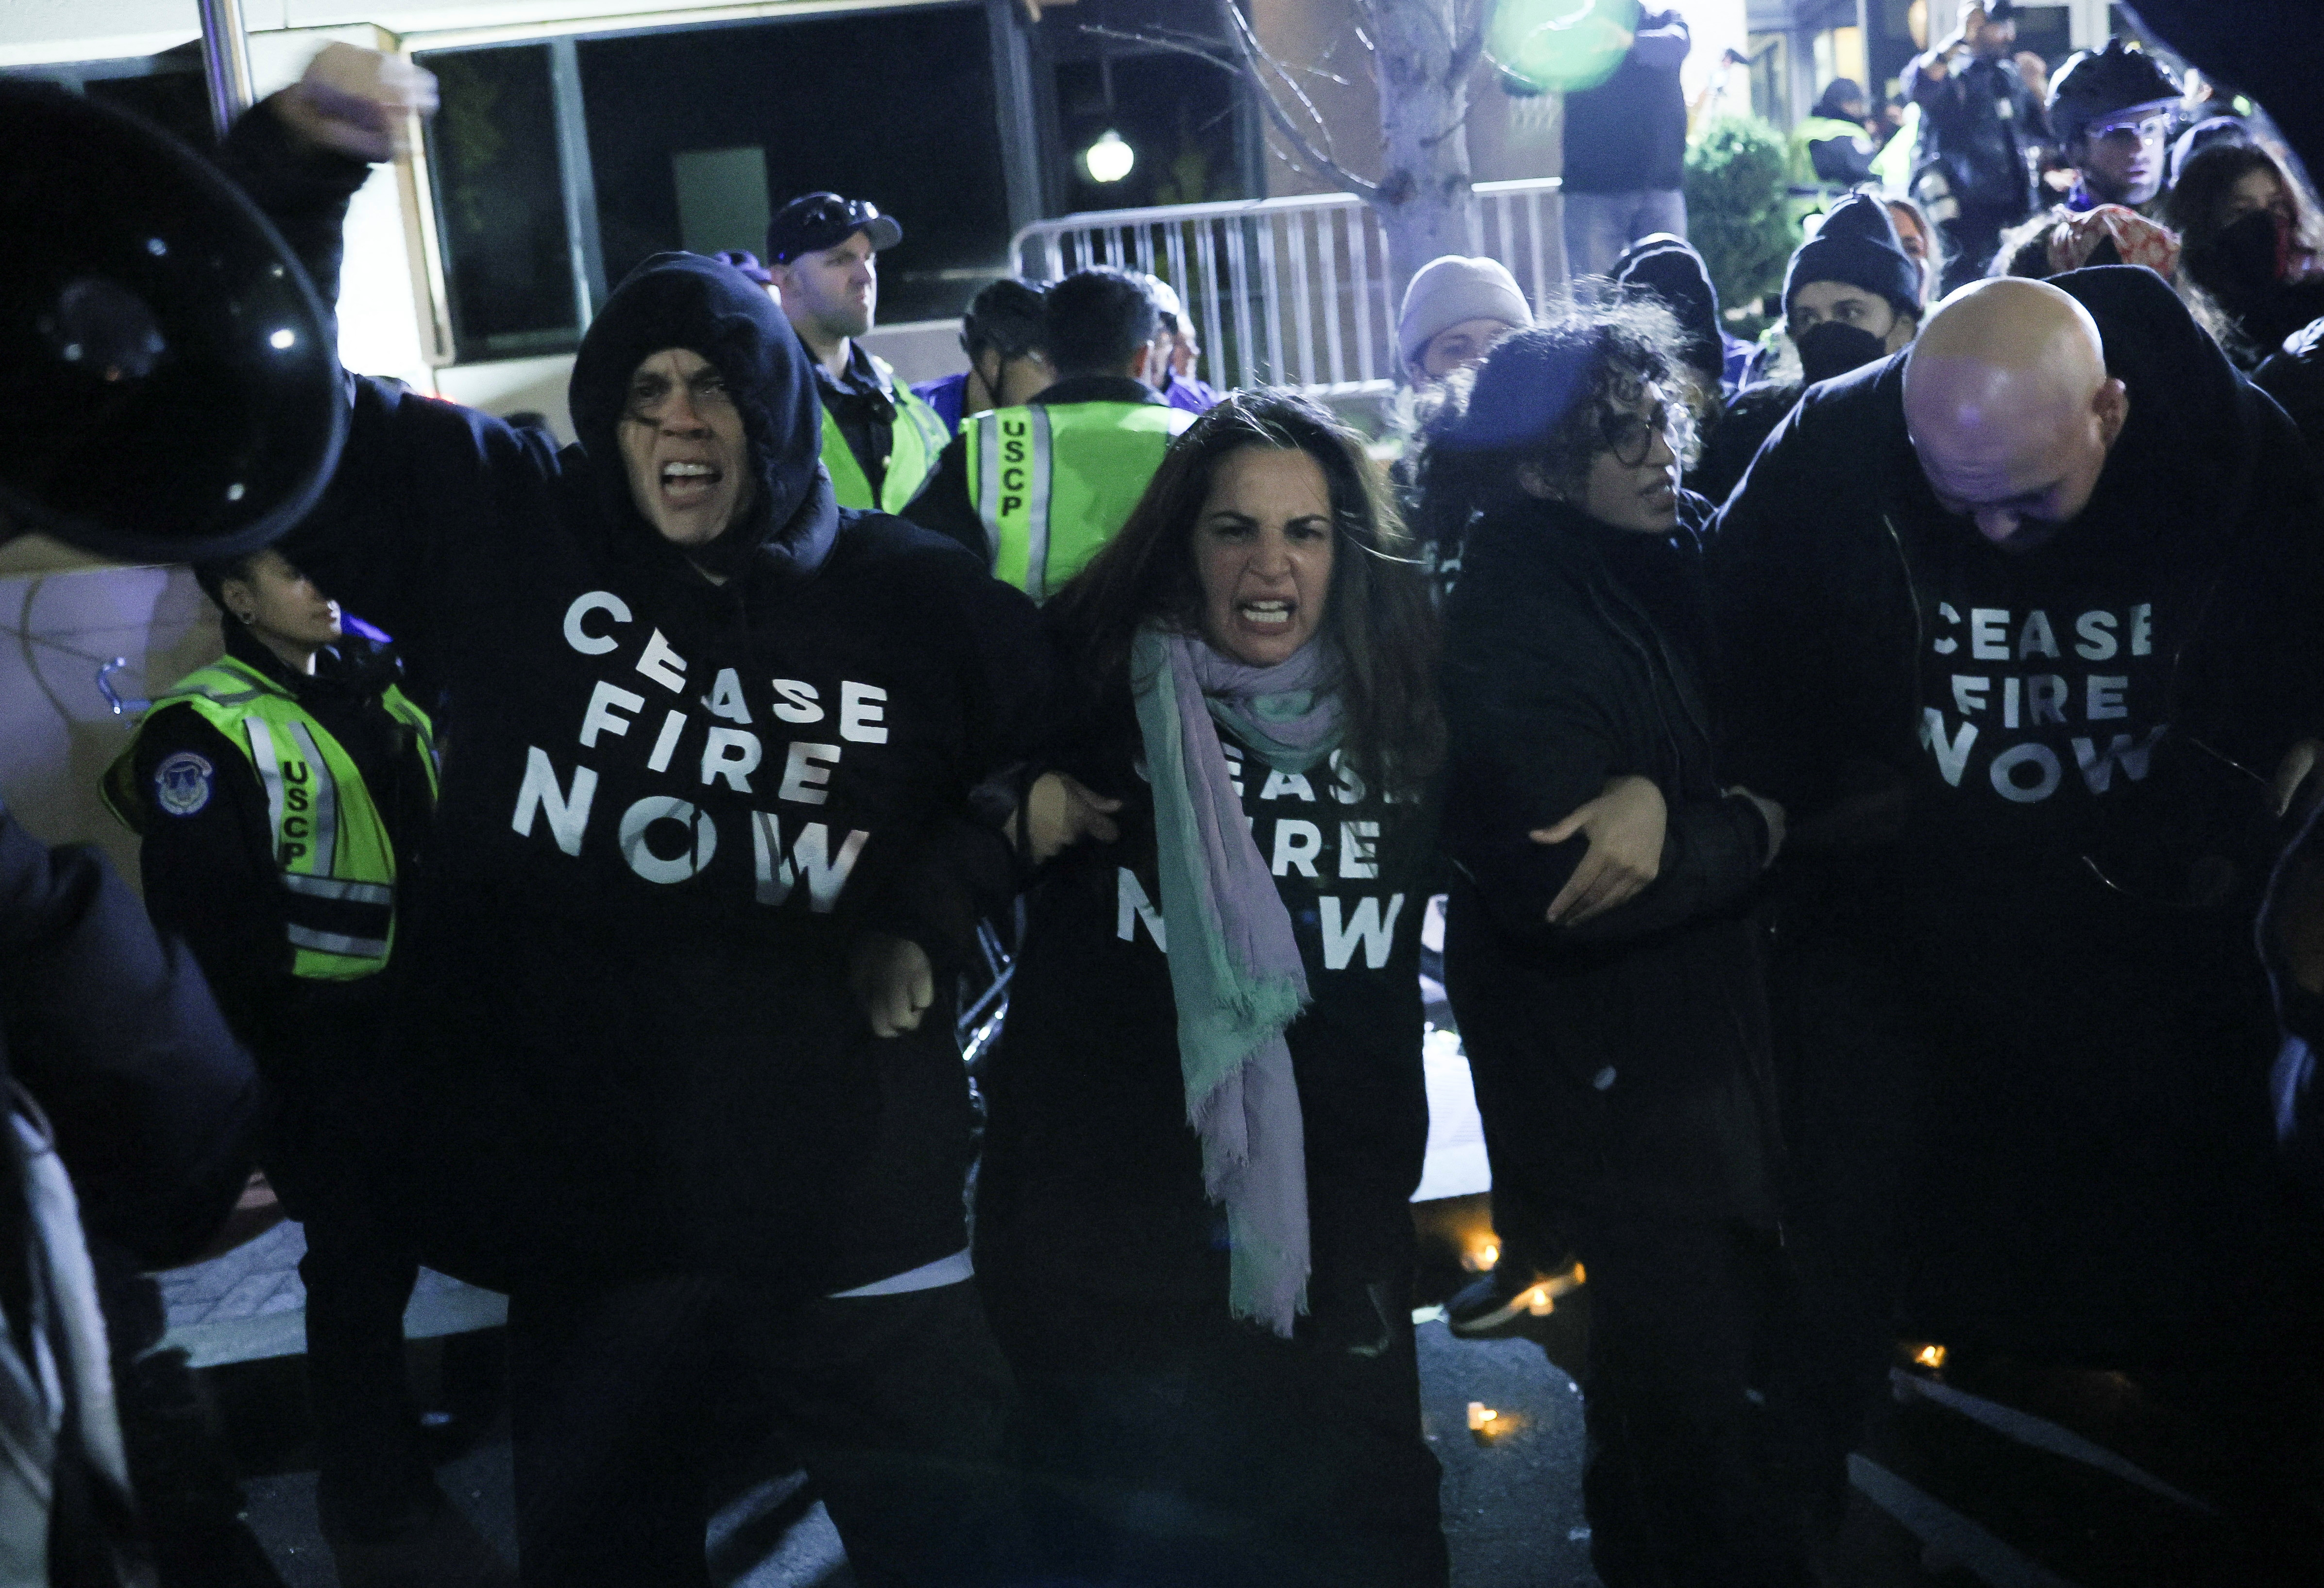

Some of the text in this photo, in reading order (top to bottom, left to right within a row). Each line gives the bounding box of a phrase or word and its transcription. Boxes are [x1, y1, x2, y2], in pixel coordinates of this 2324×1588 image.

[1002, 421, 1024, 517] USCP
[563, 591, 889, 744] CEASE
[1951, 674, 2128, 728] FIRE
[579, 680, 841, 805] FIRE
[284, 761, 309, 865] USCP
[511, 745, 869, 913] NOW
[1117, 866, 1405, 970] NW
